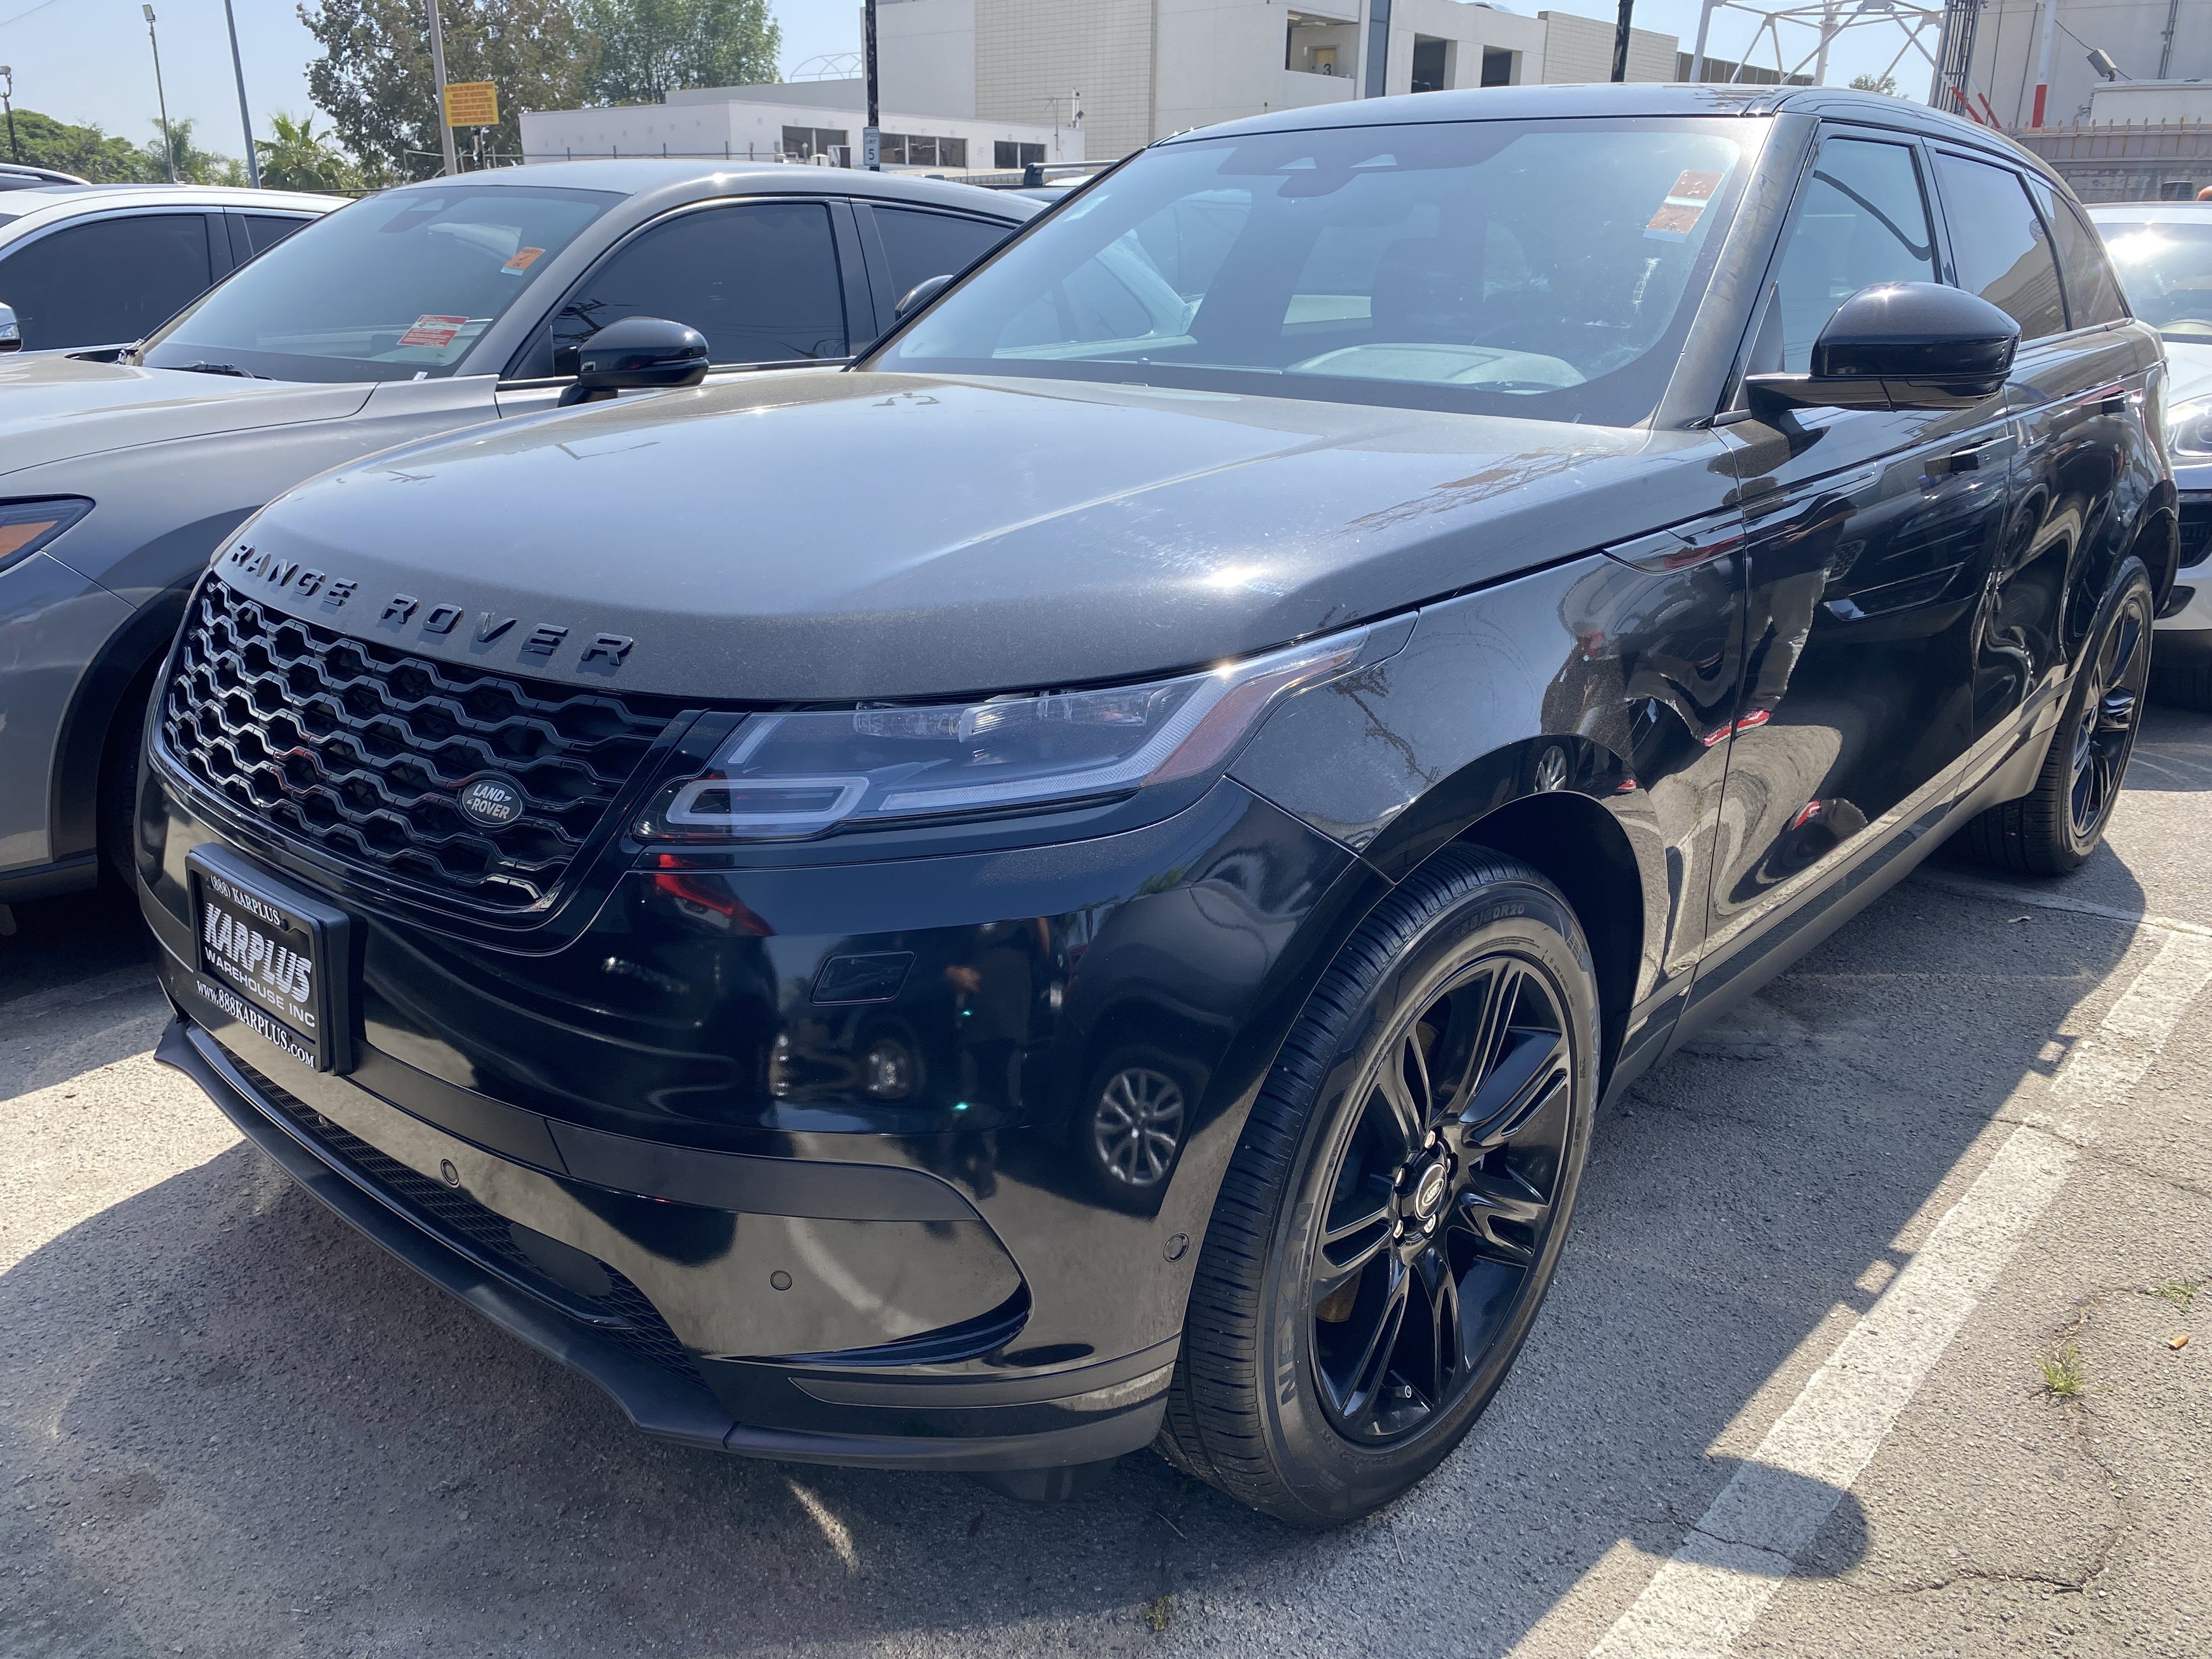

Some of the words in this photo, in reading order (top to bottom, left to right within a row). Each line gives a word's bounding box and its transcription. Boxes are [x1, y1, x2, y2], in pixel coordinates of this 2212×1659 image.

[868, 149, 875, 160] 5
[230, 543, 358, 606] RANGE
[381, 592, 635, 667] ROVER
[471, 798, 510, 819] ROVER
[472, 784, 505, 802] LAND
[210, 874, 231, 899] (888)
[232, 887, 280, 927] KARPLUS
[204, 902, 312, 1003] KARPLUS
[204, 946, 285, 1011] WAREHOUSE
[289, 1005, 315, 1028] INC
[1276, 1202, 1314, 1407] NEXEN
